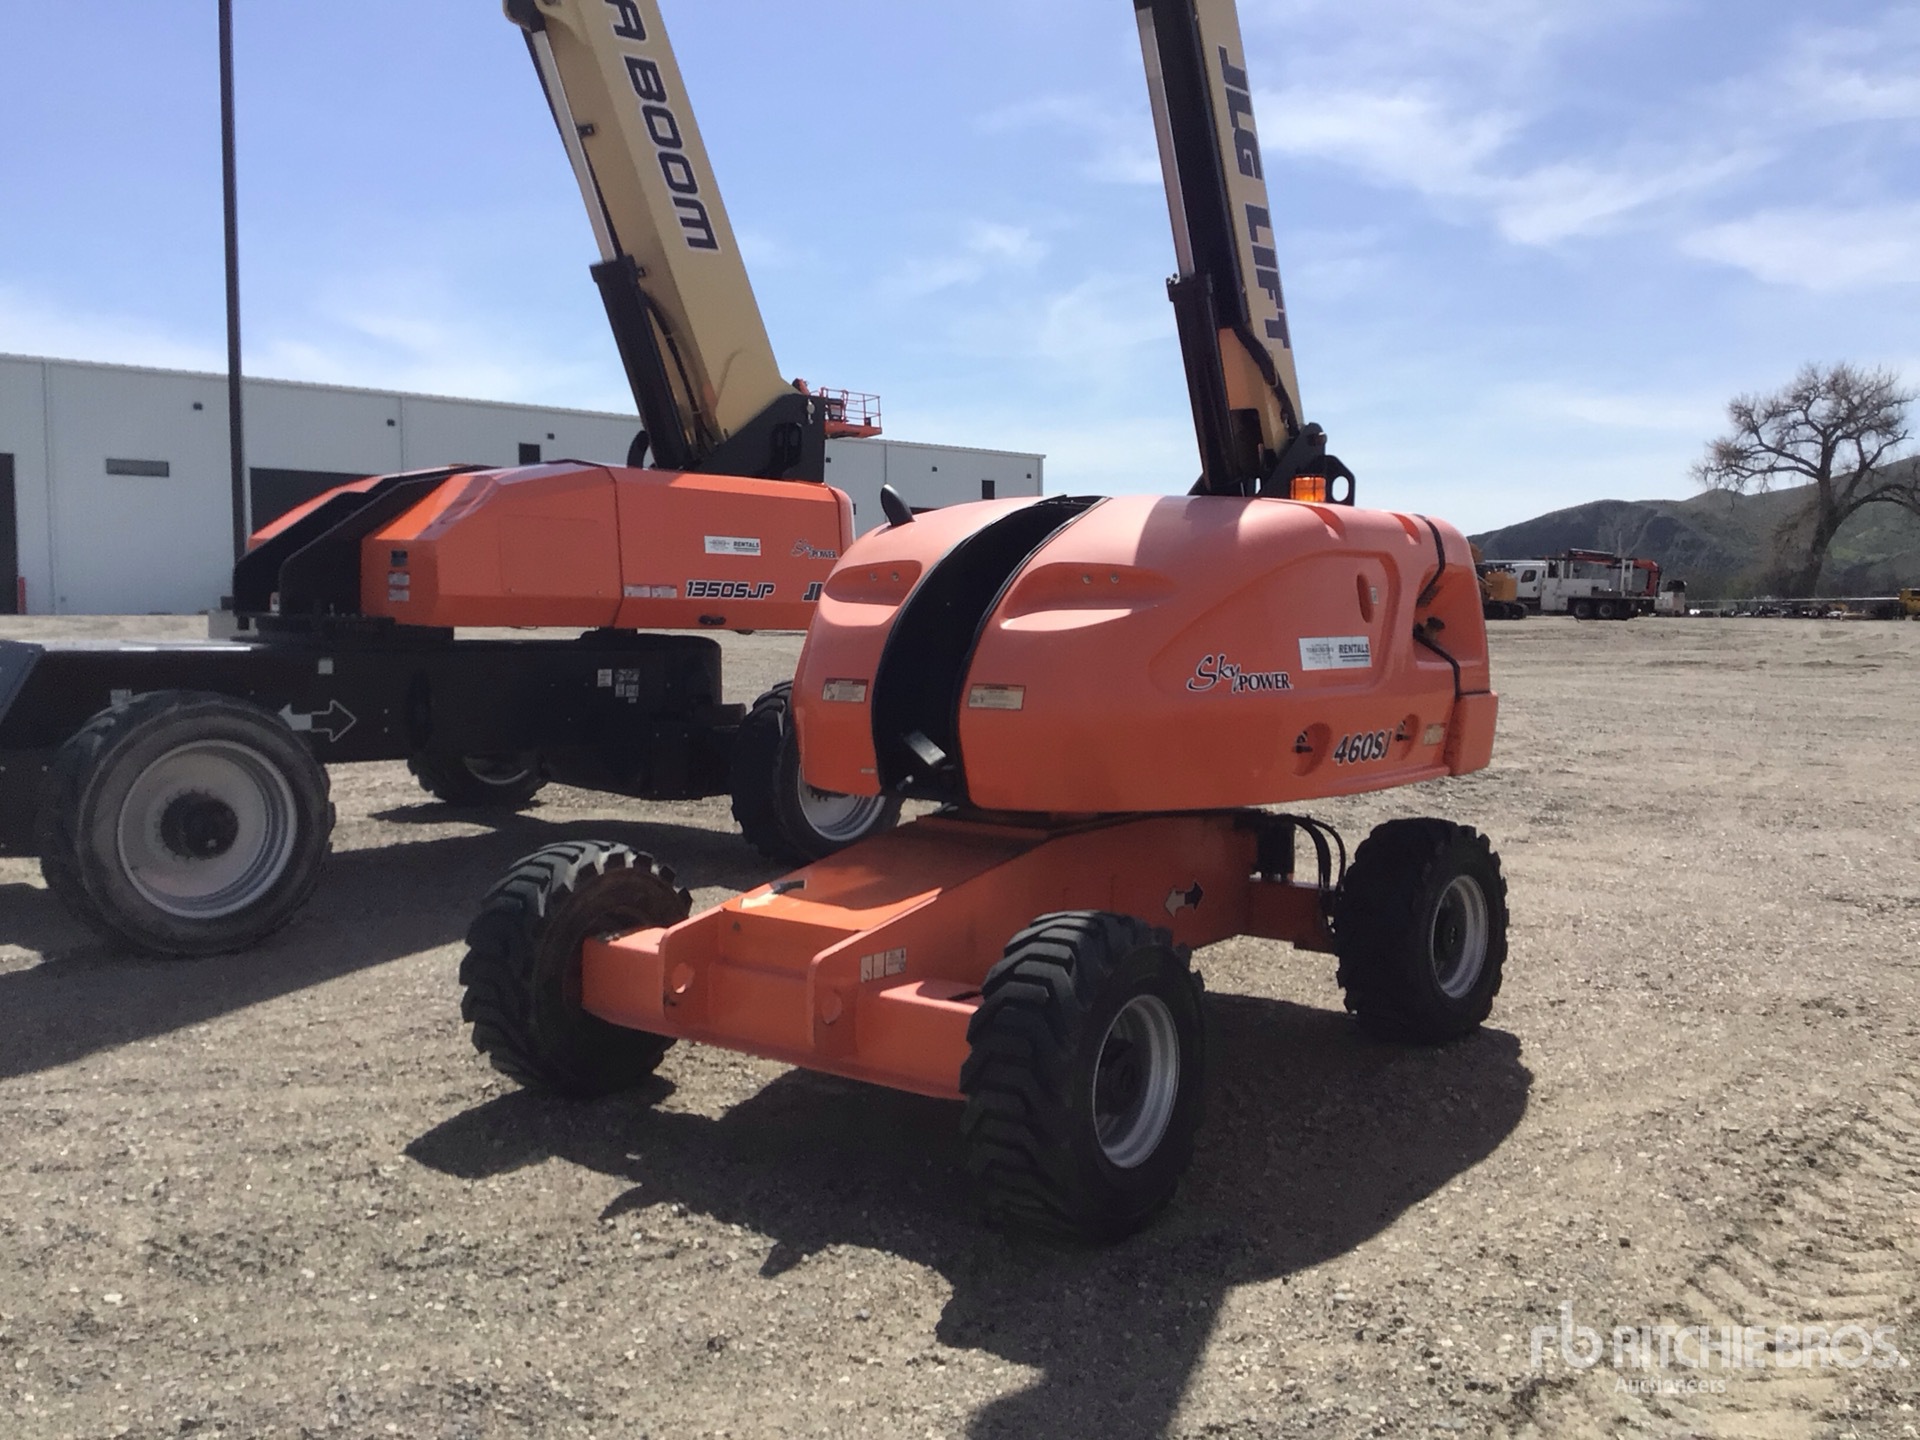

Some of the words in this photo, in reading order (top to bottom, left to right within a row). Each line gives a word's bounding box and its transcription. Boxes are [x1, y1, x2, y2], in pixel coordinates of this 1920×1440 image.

[624, 55, 719, 251] BOOM
[1218, 45, 1263, 181] JLG
[1245, 203, 1291, 350] LIFT
[733, 541, 760, 549] RENTALS
[686, 581, 775, 599] 1350SJP
[1338, 643, 1369, 654] RENTALS
[1239, 673, 1290, 691] POWER
